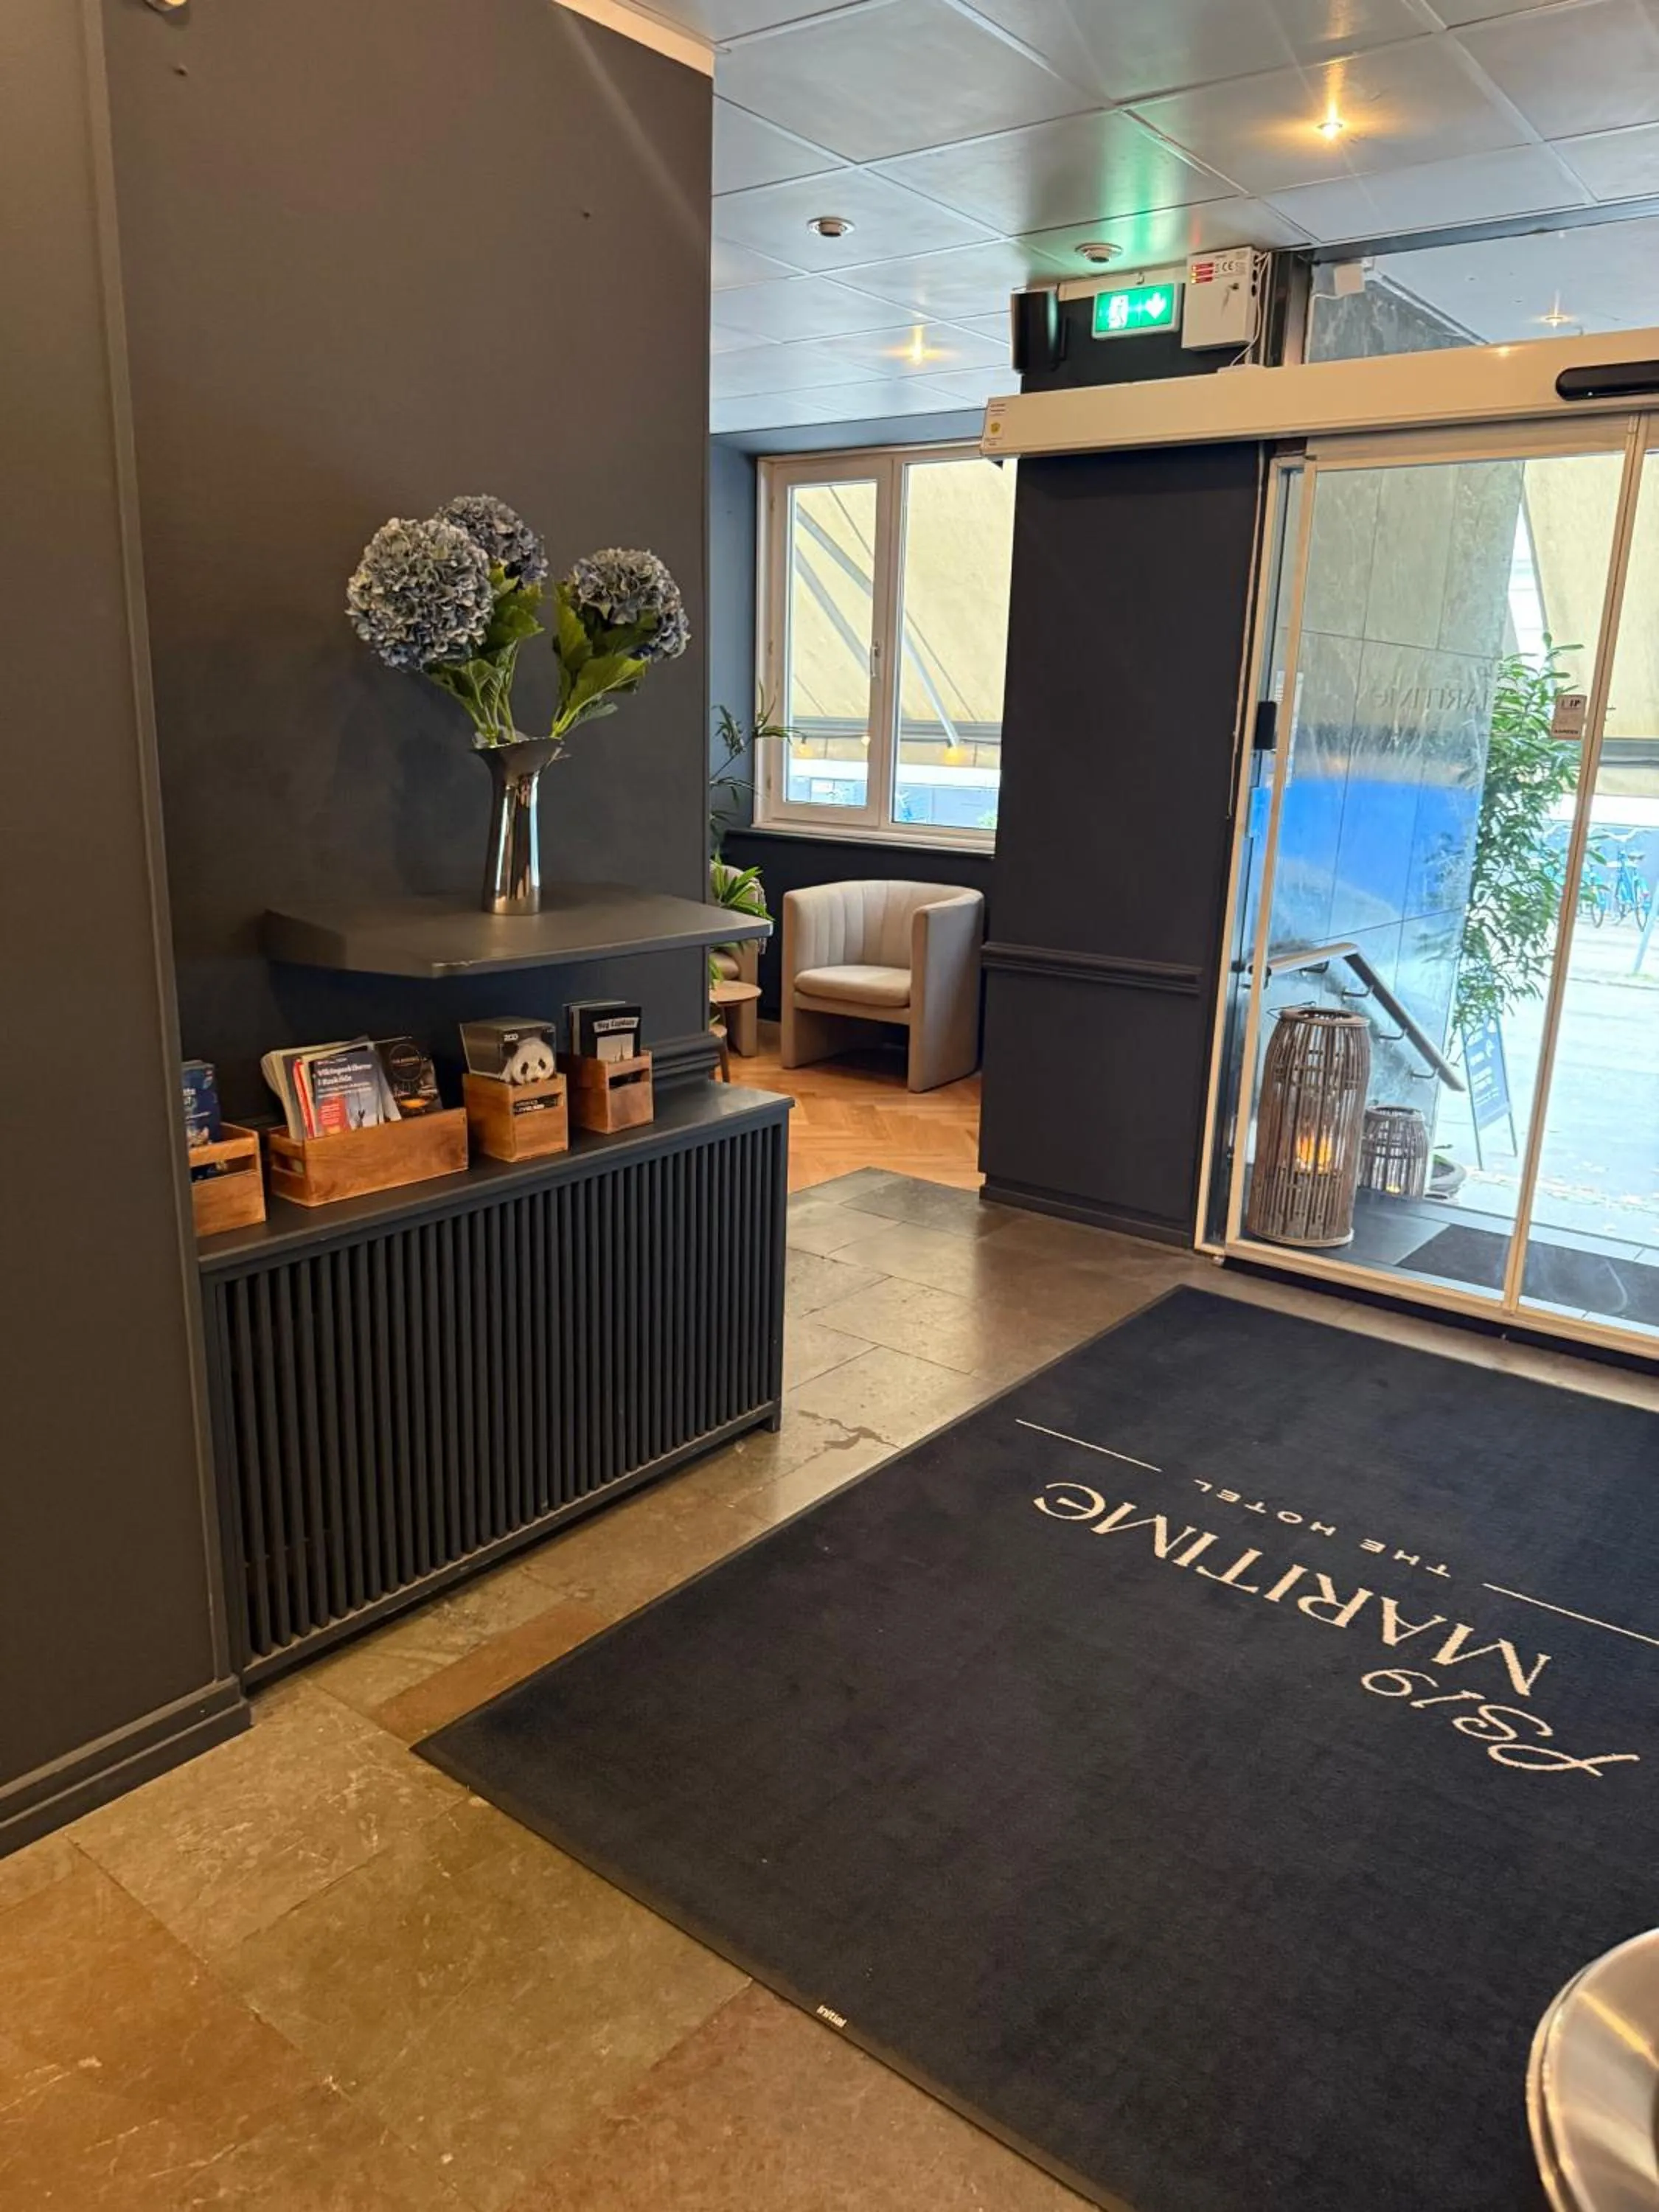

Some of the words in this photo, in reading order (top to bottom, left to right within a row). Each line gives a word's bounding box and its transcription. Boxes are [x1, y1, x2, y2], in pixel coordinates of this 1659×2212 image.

[1194, 1479, 1337, 1537] HOTEL
[1360, 1538, 1451, 1578] THE
[1034, 1482, 1551, 1697] MARITIME
